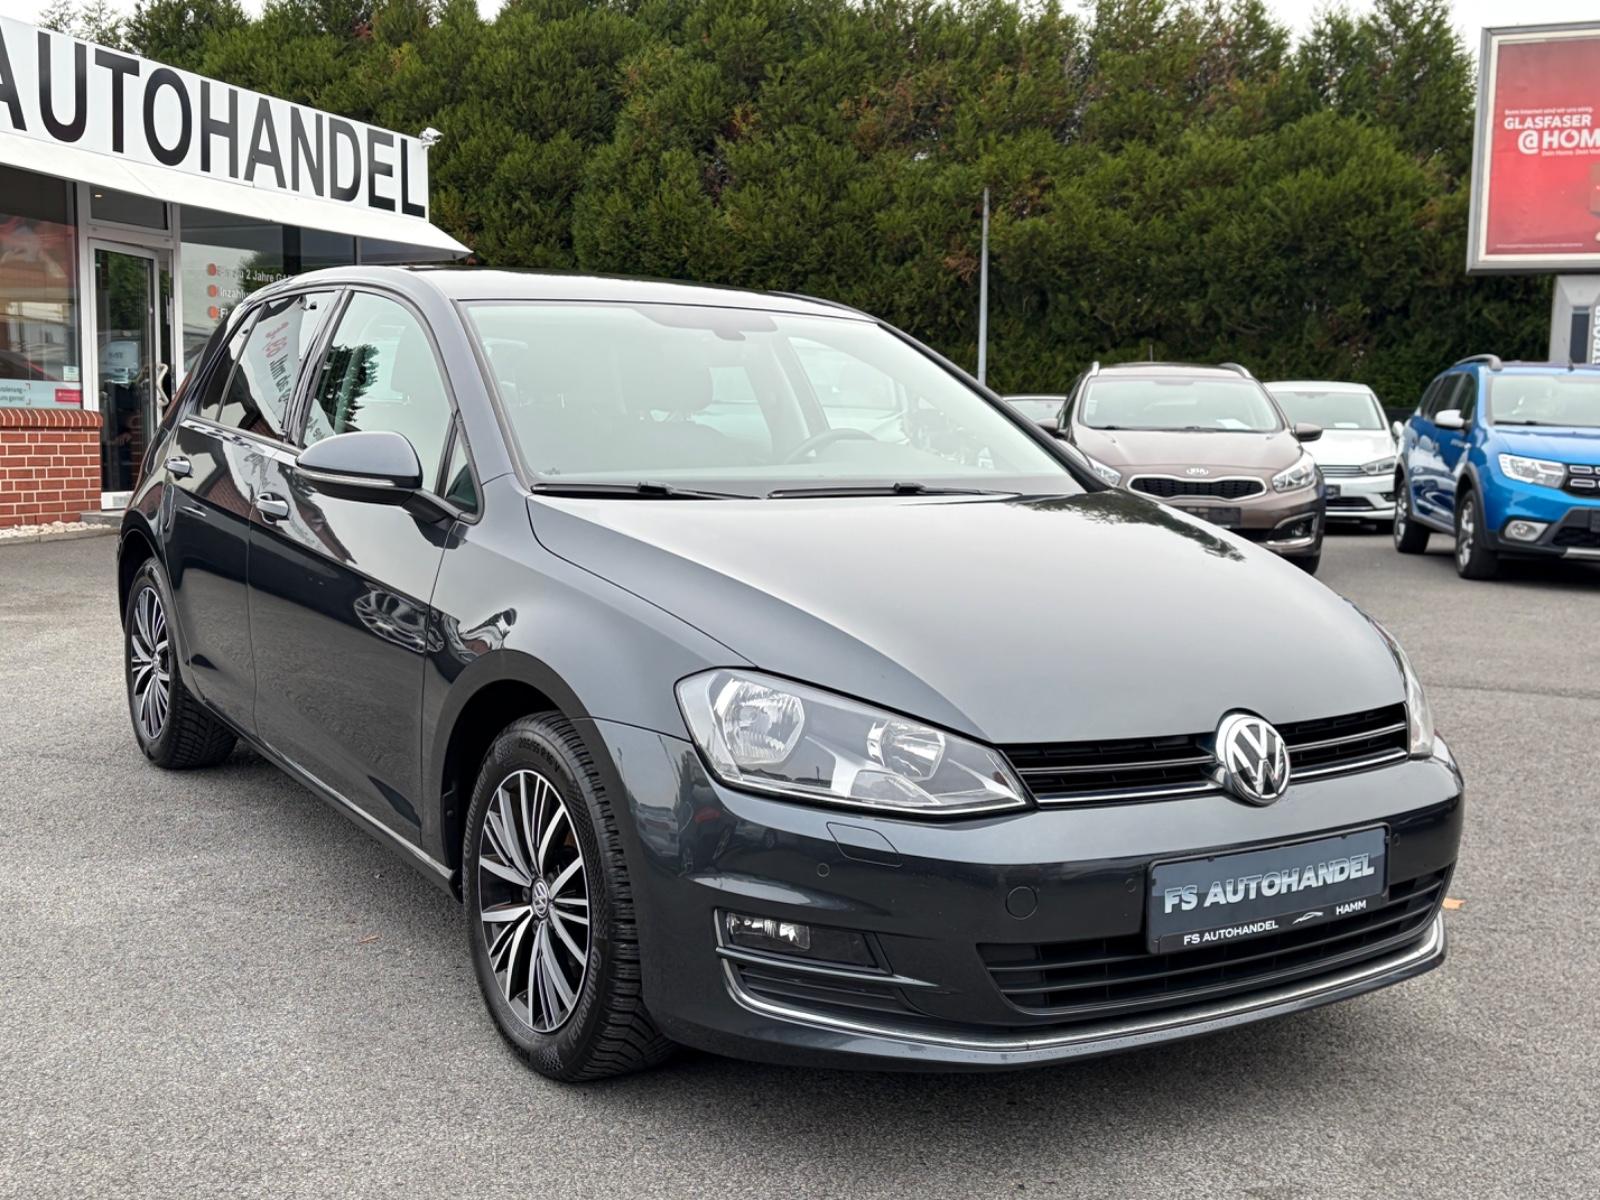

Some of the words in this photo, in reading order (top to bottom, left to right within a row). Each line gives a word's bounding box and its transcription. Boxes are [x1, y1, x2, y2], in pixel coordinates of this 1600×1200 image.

[1504, 114, 1592, 130] GLASFASER
[252, 270, 274, 283] Jahre
[1164, 885, 1198, 913] FS
[1203, 853, 1375, 908] AUTOHANDEL
[1183, 934, 1200, 945] FS
[1202, 920, 1278, 942] AUTOHANDEL
[1336, 900, 1367, 915] HAMM
